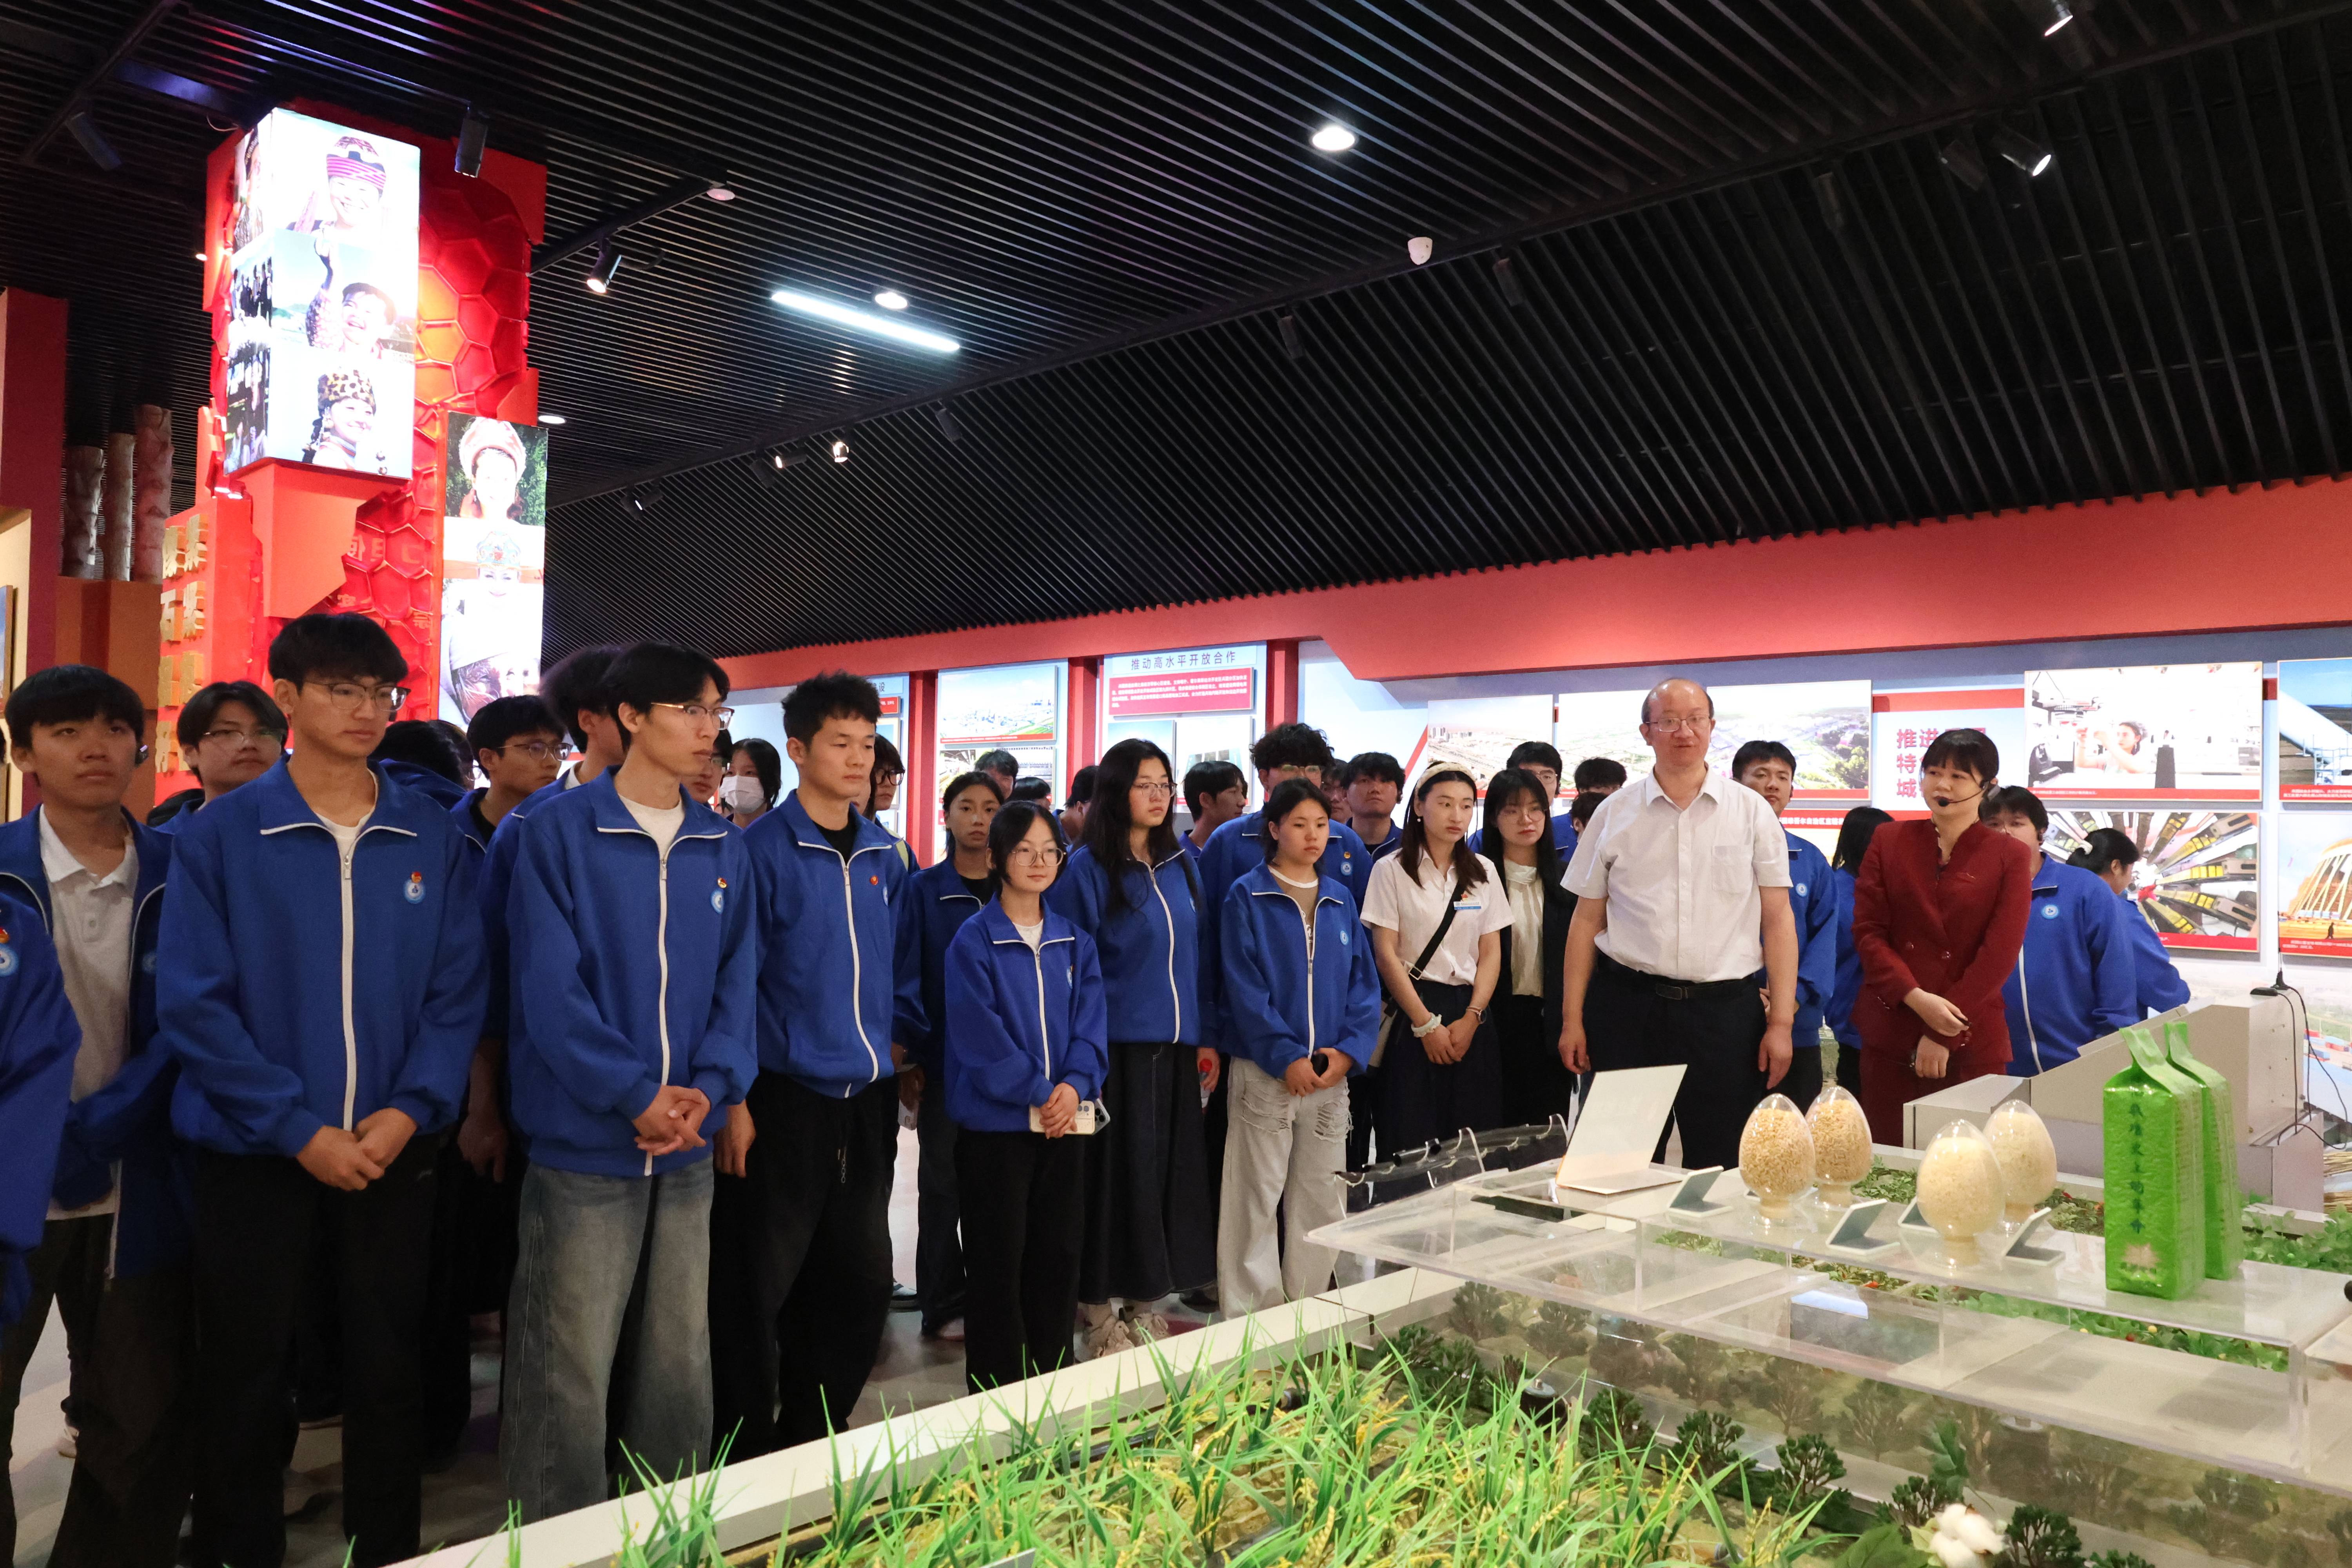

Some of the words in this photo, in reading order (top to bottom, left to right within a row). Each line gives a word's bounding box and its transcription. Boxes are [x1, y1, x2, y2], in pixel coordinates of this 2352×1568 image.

[1131, 651, 1236, 670] 推动高水平开放合作
